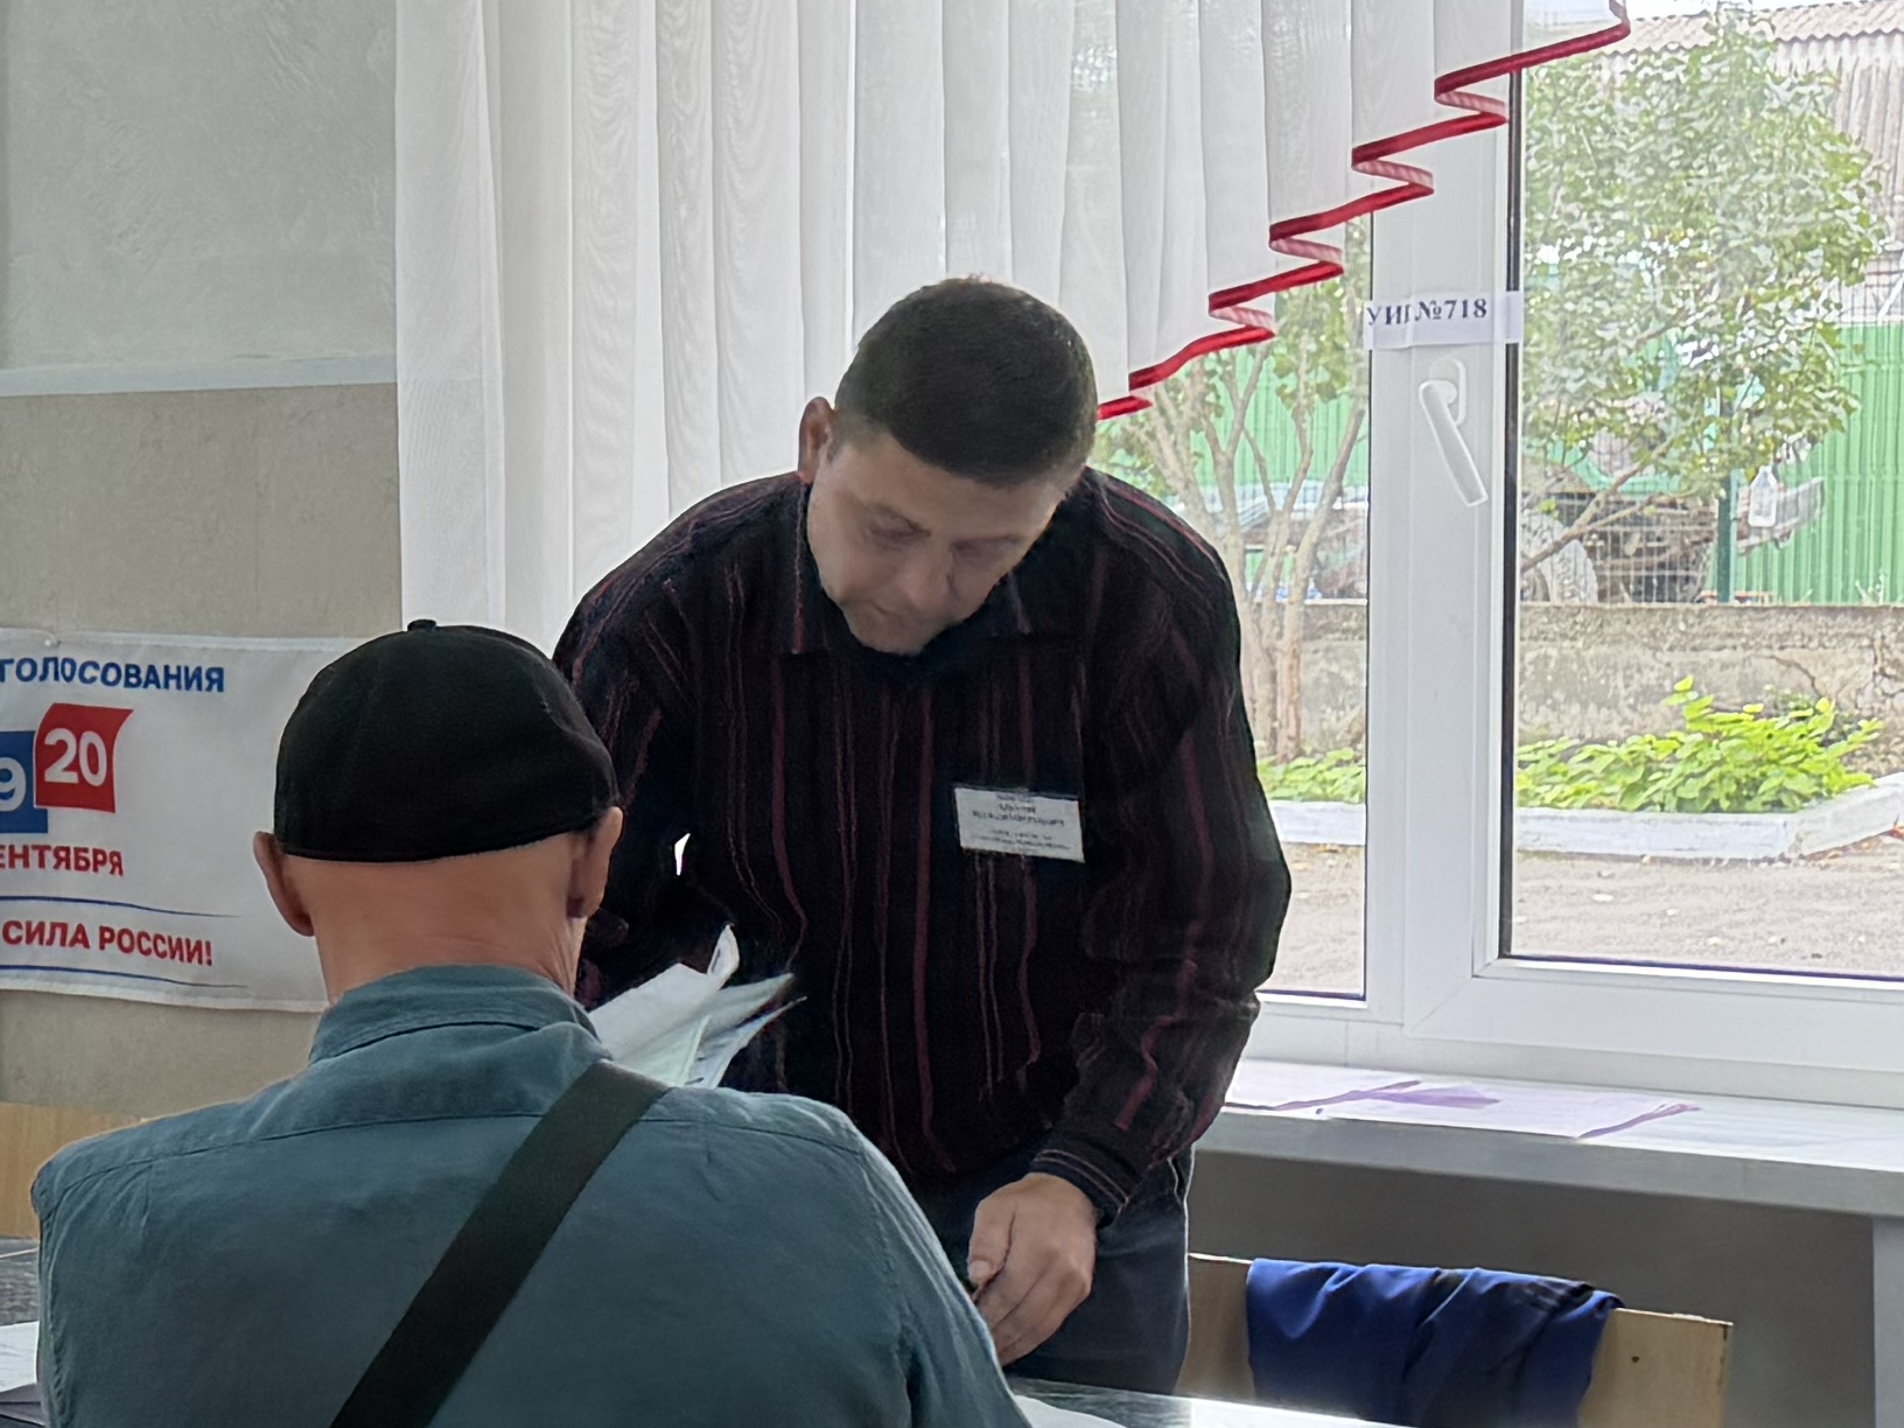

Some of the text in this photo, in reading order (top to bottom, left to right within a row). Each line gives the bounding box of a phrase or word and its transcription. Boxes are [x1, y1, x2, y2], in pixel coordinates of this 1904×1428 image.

[44, 727, 107, 787] 20
[1, 919, 91, 949] СИЛА
[98, 925, 213, 967] РОССИИ!
